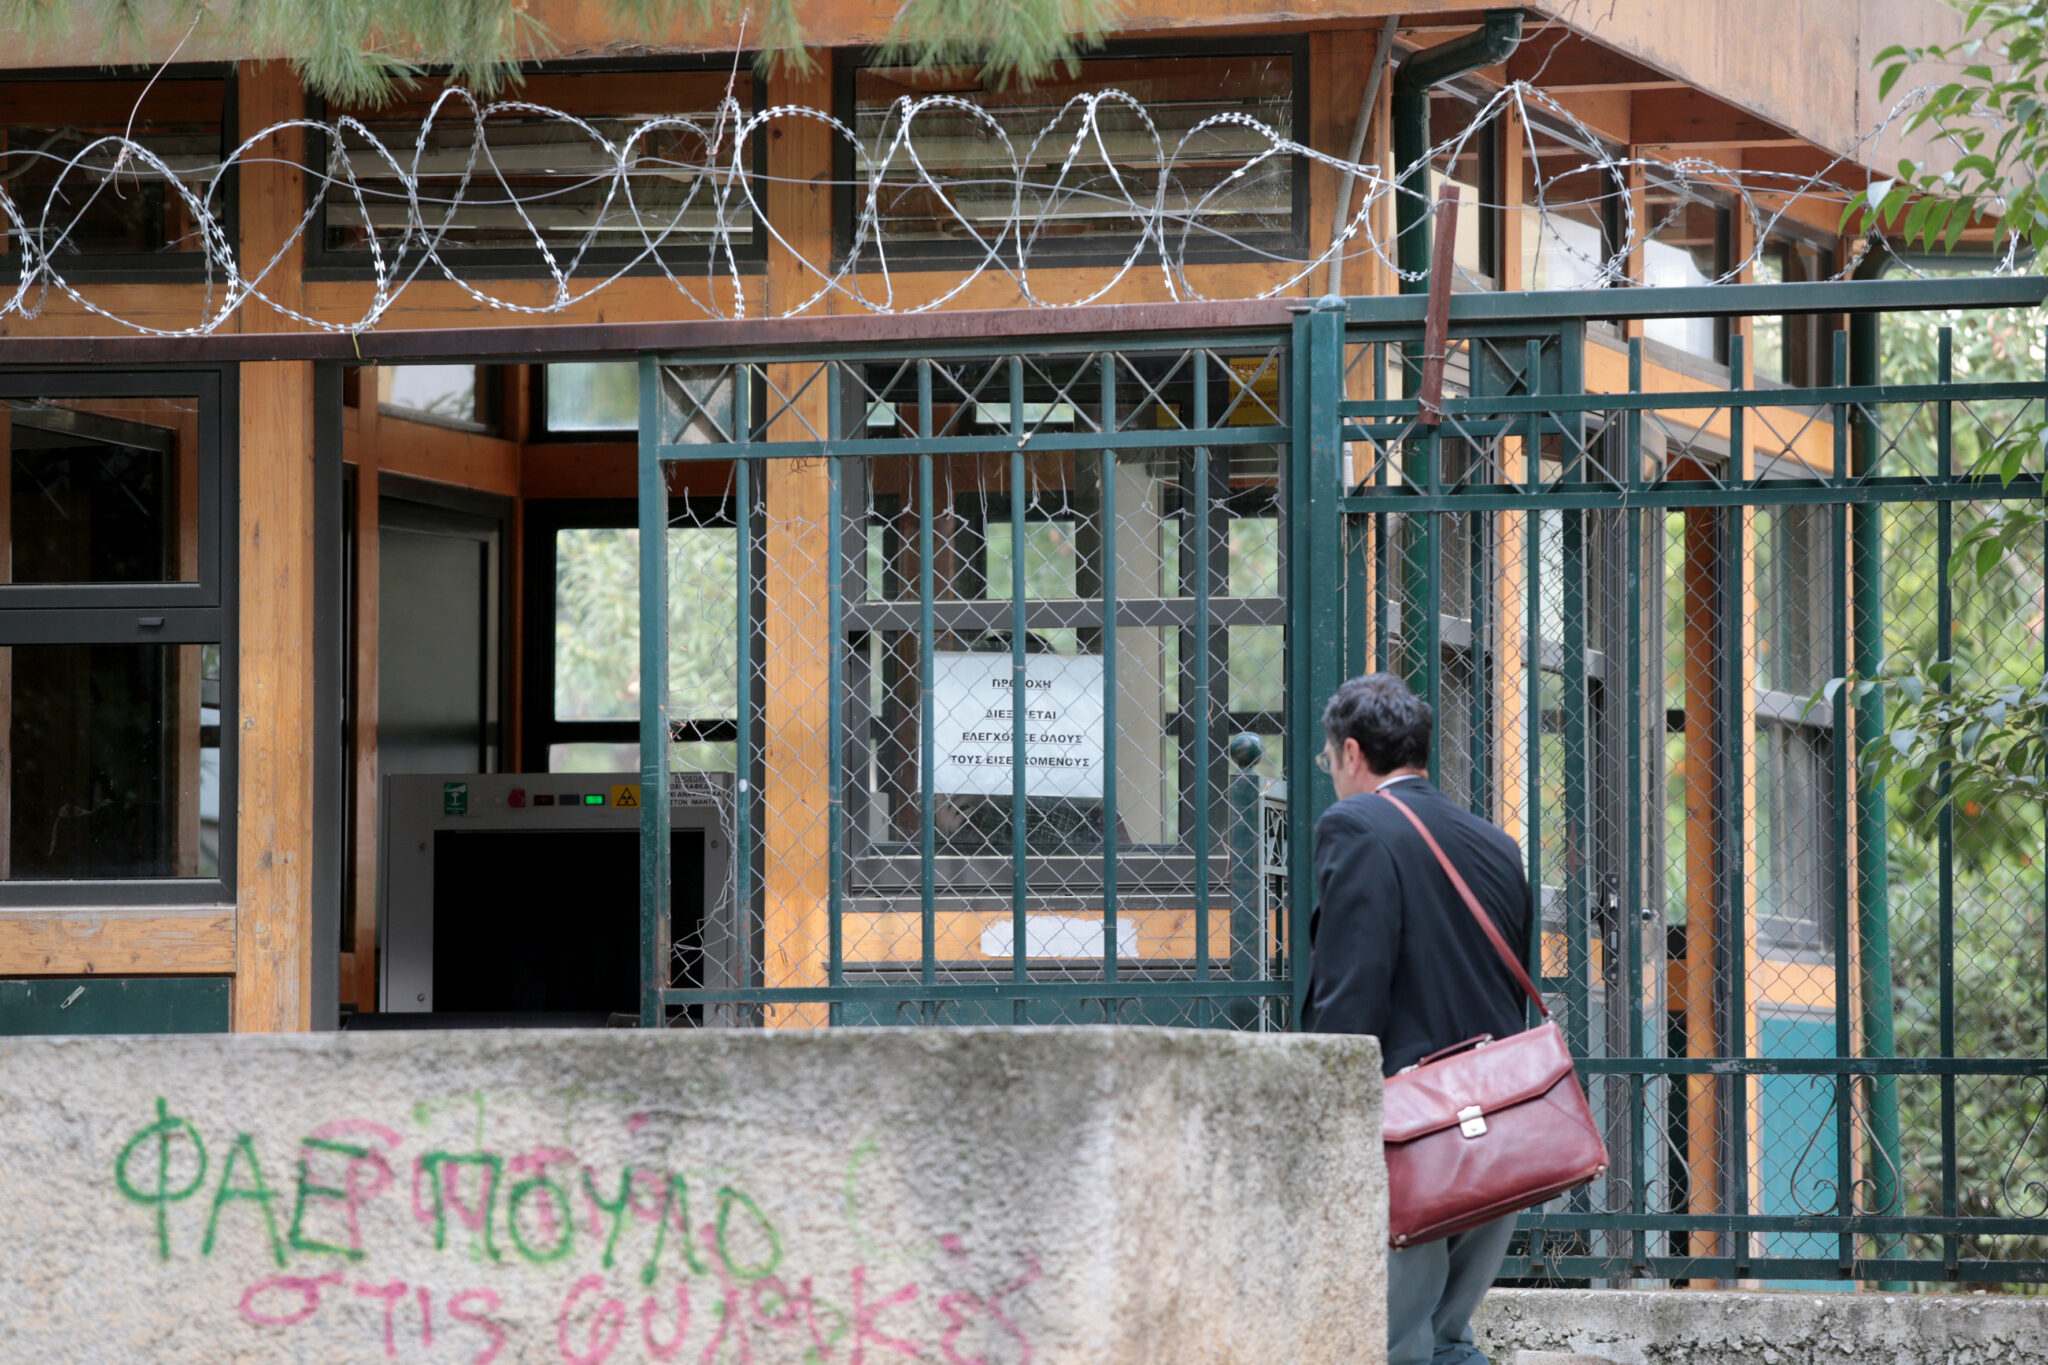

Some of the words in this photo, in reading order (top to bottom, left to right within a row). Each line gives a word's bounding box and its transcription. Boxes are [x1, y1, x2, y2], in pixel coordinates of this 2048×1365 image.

[992, 678, 1051, 690] ΠΡΟΟΧΗ
[985, 709, 1056, 721] ΔΙΕΞΕΤΑΙ
[1040, 734, 1082, 744] ΟΛΟΥΣ
[950, 755, 982, 766] ΤΟΥΣ
[986, 755, 1090, 768] ΕΙΣΕΟΜΕΝΟΥΣ
